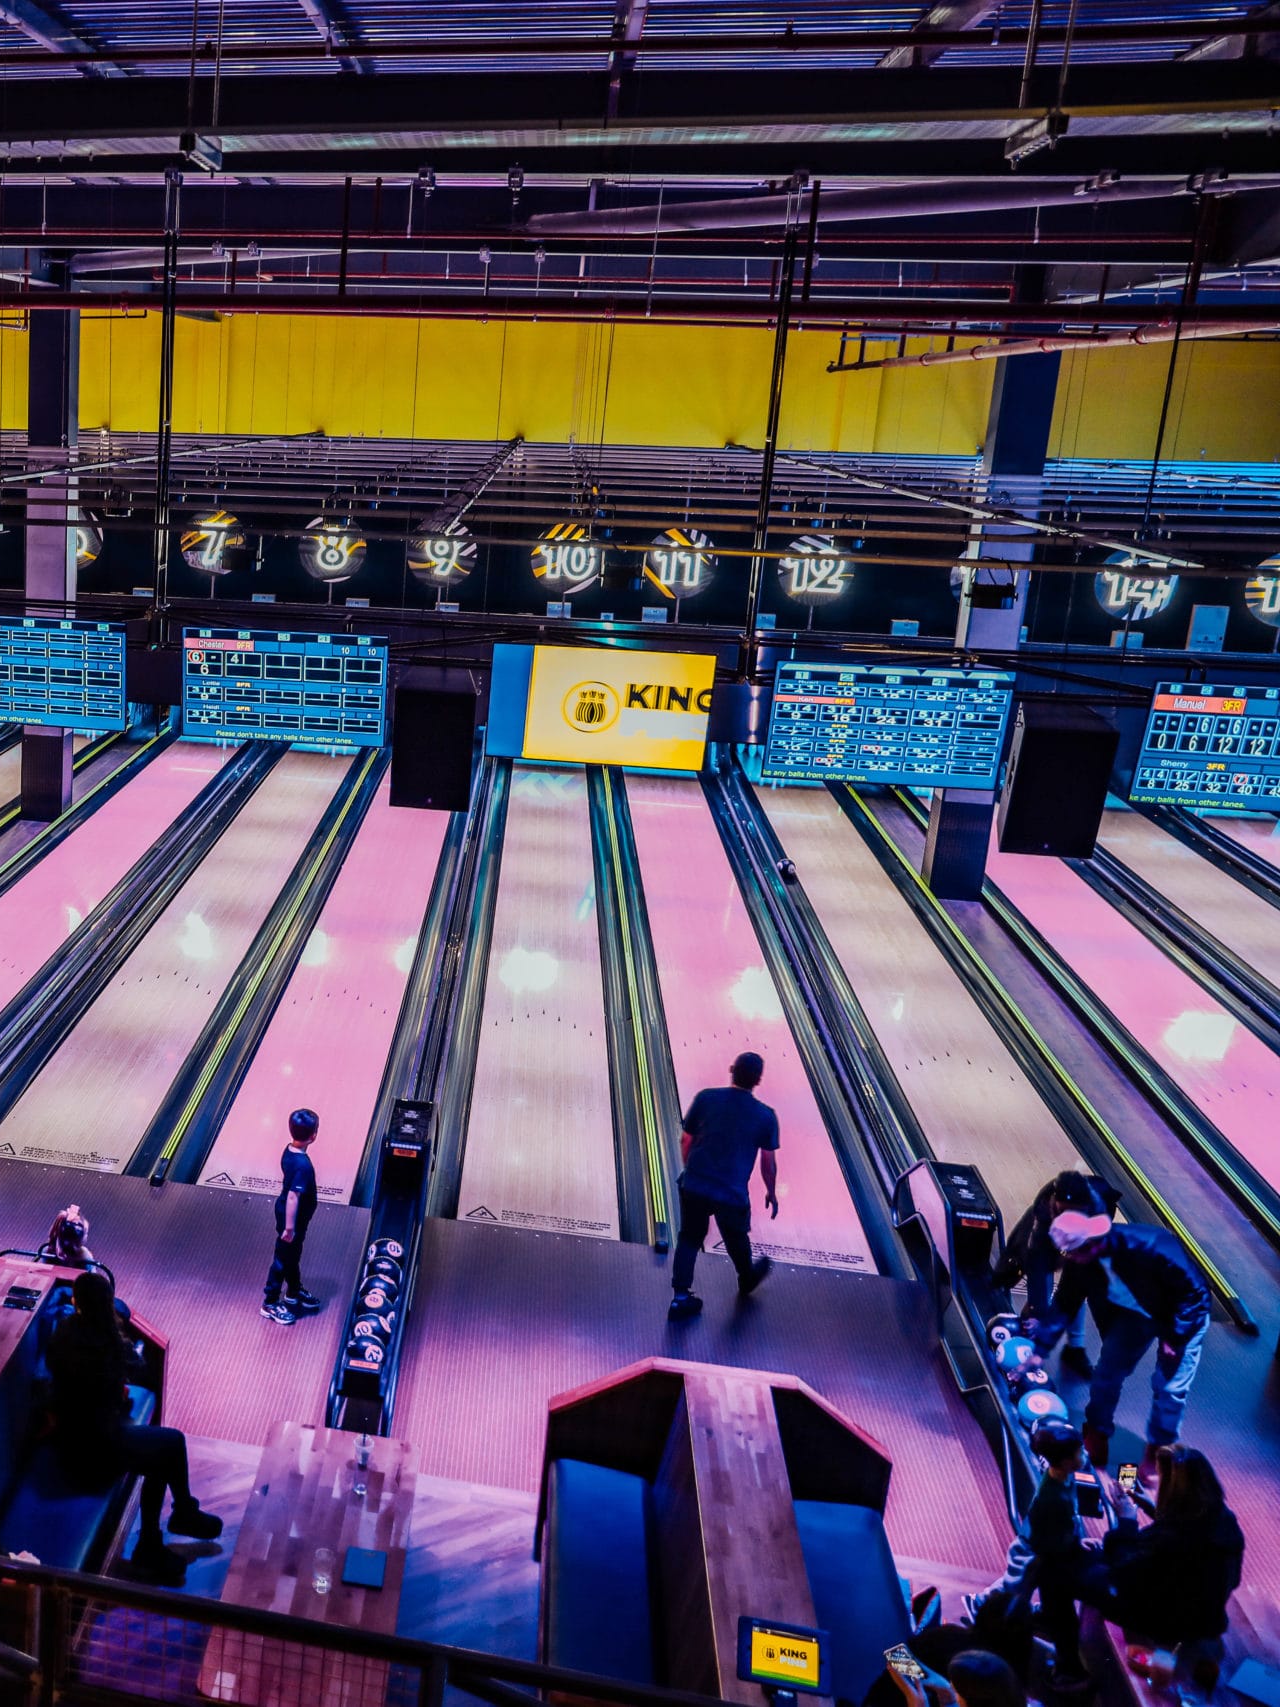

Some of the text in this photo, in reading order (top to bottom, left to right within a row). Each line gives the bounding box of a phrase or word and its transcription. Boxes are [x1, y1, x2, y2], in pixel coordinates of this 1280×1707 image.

[199, 521, 227, 566] 7
[316, 527, 349, 571] 8
[542, 537, 595, 580] 10
[654, 541, 703, 587] 11
[784, 546, 845, 593] 12
[198, 640, 224, 648] Chester
[341, 646, 350, 655] 10
[367, 647, 376, 656] 10
[200, 664, 209, 675] 6
[1173, 698, 1243, 711] Manual 3FR
[832, 714, 850, 722] 16
[876, 716, 896, 724] 24
[924, 718, 942, 727] 31
[1201, 717, 1242, 734] 6 6
[299, 734, 315, 742] from
[1157, 733, 1266, 755] 0 6 12 12
[1160, 759, 1226, 771] Sherry 3FR
[825, 772, 845, 780] other
[1174, 781, 1189, 791] 25
[1206, 783, 1221, 793] 32
[1237, 785, 1253, 794] 40
[1140, 796, 1245, 808] any balls from other lanes.
[779, 1647, 808, 1661] KING
